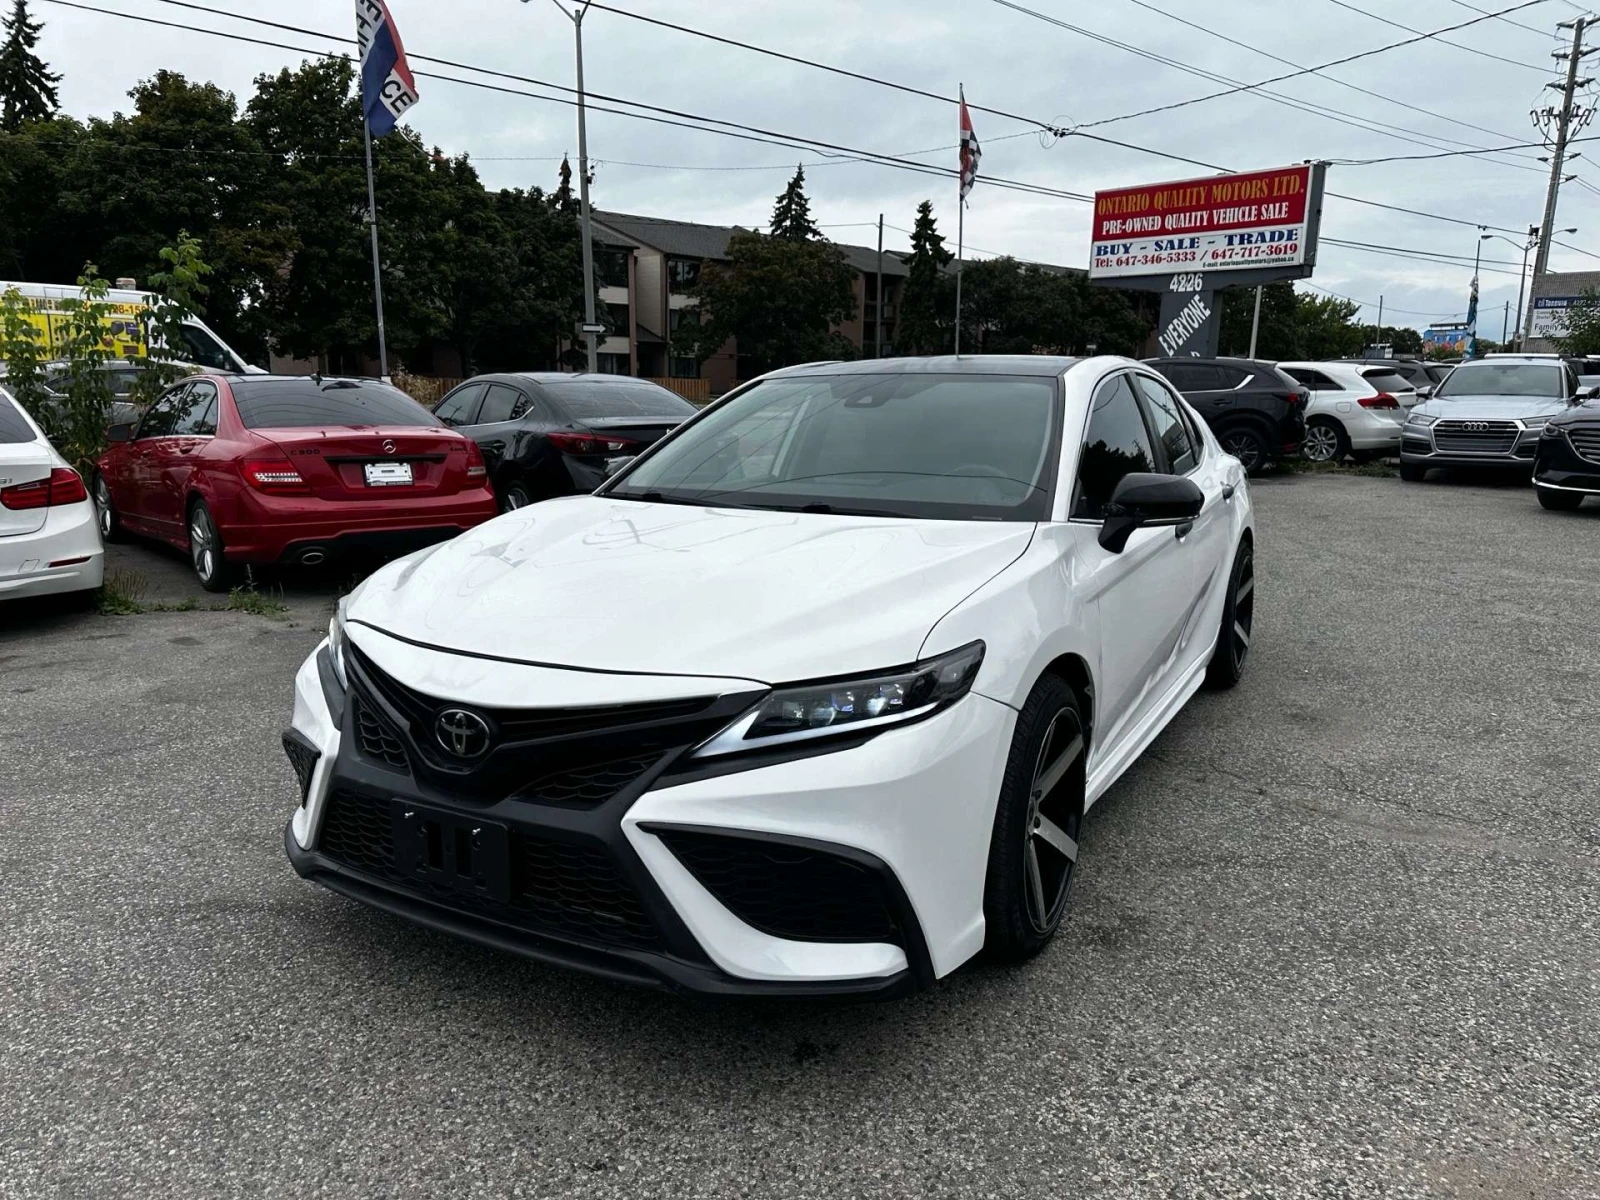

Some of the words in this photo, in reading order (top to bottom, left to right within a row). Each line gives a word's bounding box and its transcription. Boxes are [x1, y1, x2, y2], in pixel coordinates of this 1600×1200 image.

[1098, 193, 1150, 216] ONTARIO
[1154, 186, 1208, 210] QUALITY
[1212, 178, 1269, 203] MOTORS
[1272, 174, 1304, 196] LTD.
[1102, 216, 1161, 235] PRE-OWNED
[1164, 210, 1209, 231] QUALITY
[1213, 205, 1258, 225] VEHICLE
[1261, 202, 1289, 220] SALE
[1095, 257, 1113, 268] Tel:
[1116, 251, 1196, 267] 647-346-5333
[1211, 243, 1298, 260] 647-717-3619
[1096, 243, 1133, 257] BUY
[1154, 237, 1200, 252] SALE
[1224, 229, 1298, 246] TRADE
[1170, 273, 1203, 292] 4226
[1159, 294, 1211, 357] EVERYONE
